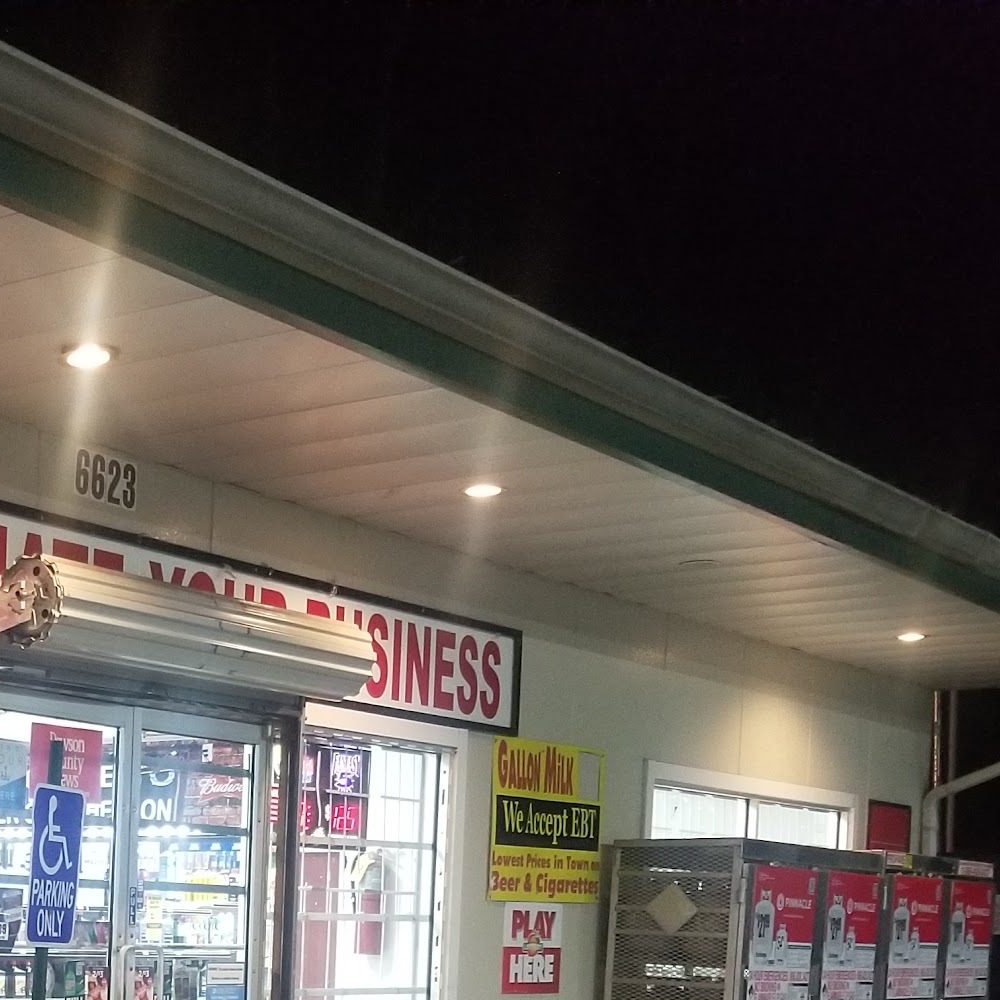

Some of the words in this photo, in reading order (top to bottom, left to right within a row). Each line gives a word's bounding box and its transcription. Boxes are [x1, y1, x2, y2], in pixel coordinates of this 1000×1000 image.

[75, 448, 136, 509] 6623
[60, 774, 80, 788] ews
[497, 739, 542, 793] GALLON
[502, 799, 524, 834] We
[524, 802, 569, 846] Accept
[570, 807, 597, 839] EBT
[491, 850, 525, 868] Lowest
[525, 852, 551, 870] Prices
[553, 854, 564, 870] in
[566, 855, 590, 872] Town
[31, 878, 75, 909] PARKING
[523, 872, 533, 893] &
[535, 872, 600, 899] Cigarettes
[129, 887, 137, 926] PULL
[36, 908, 65, 938] ONLY
[511, 909, 557, 940] PLAY
[508, 953, 555, 984] HERE
